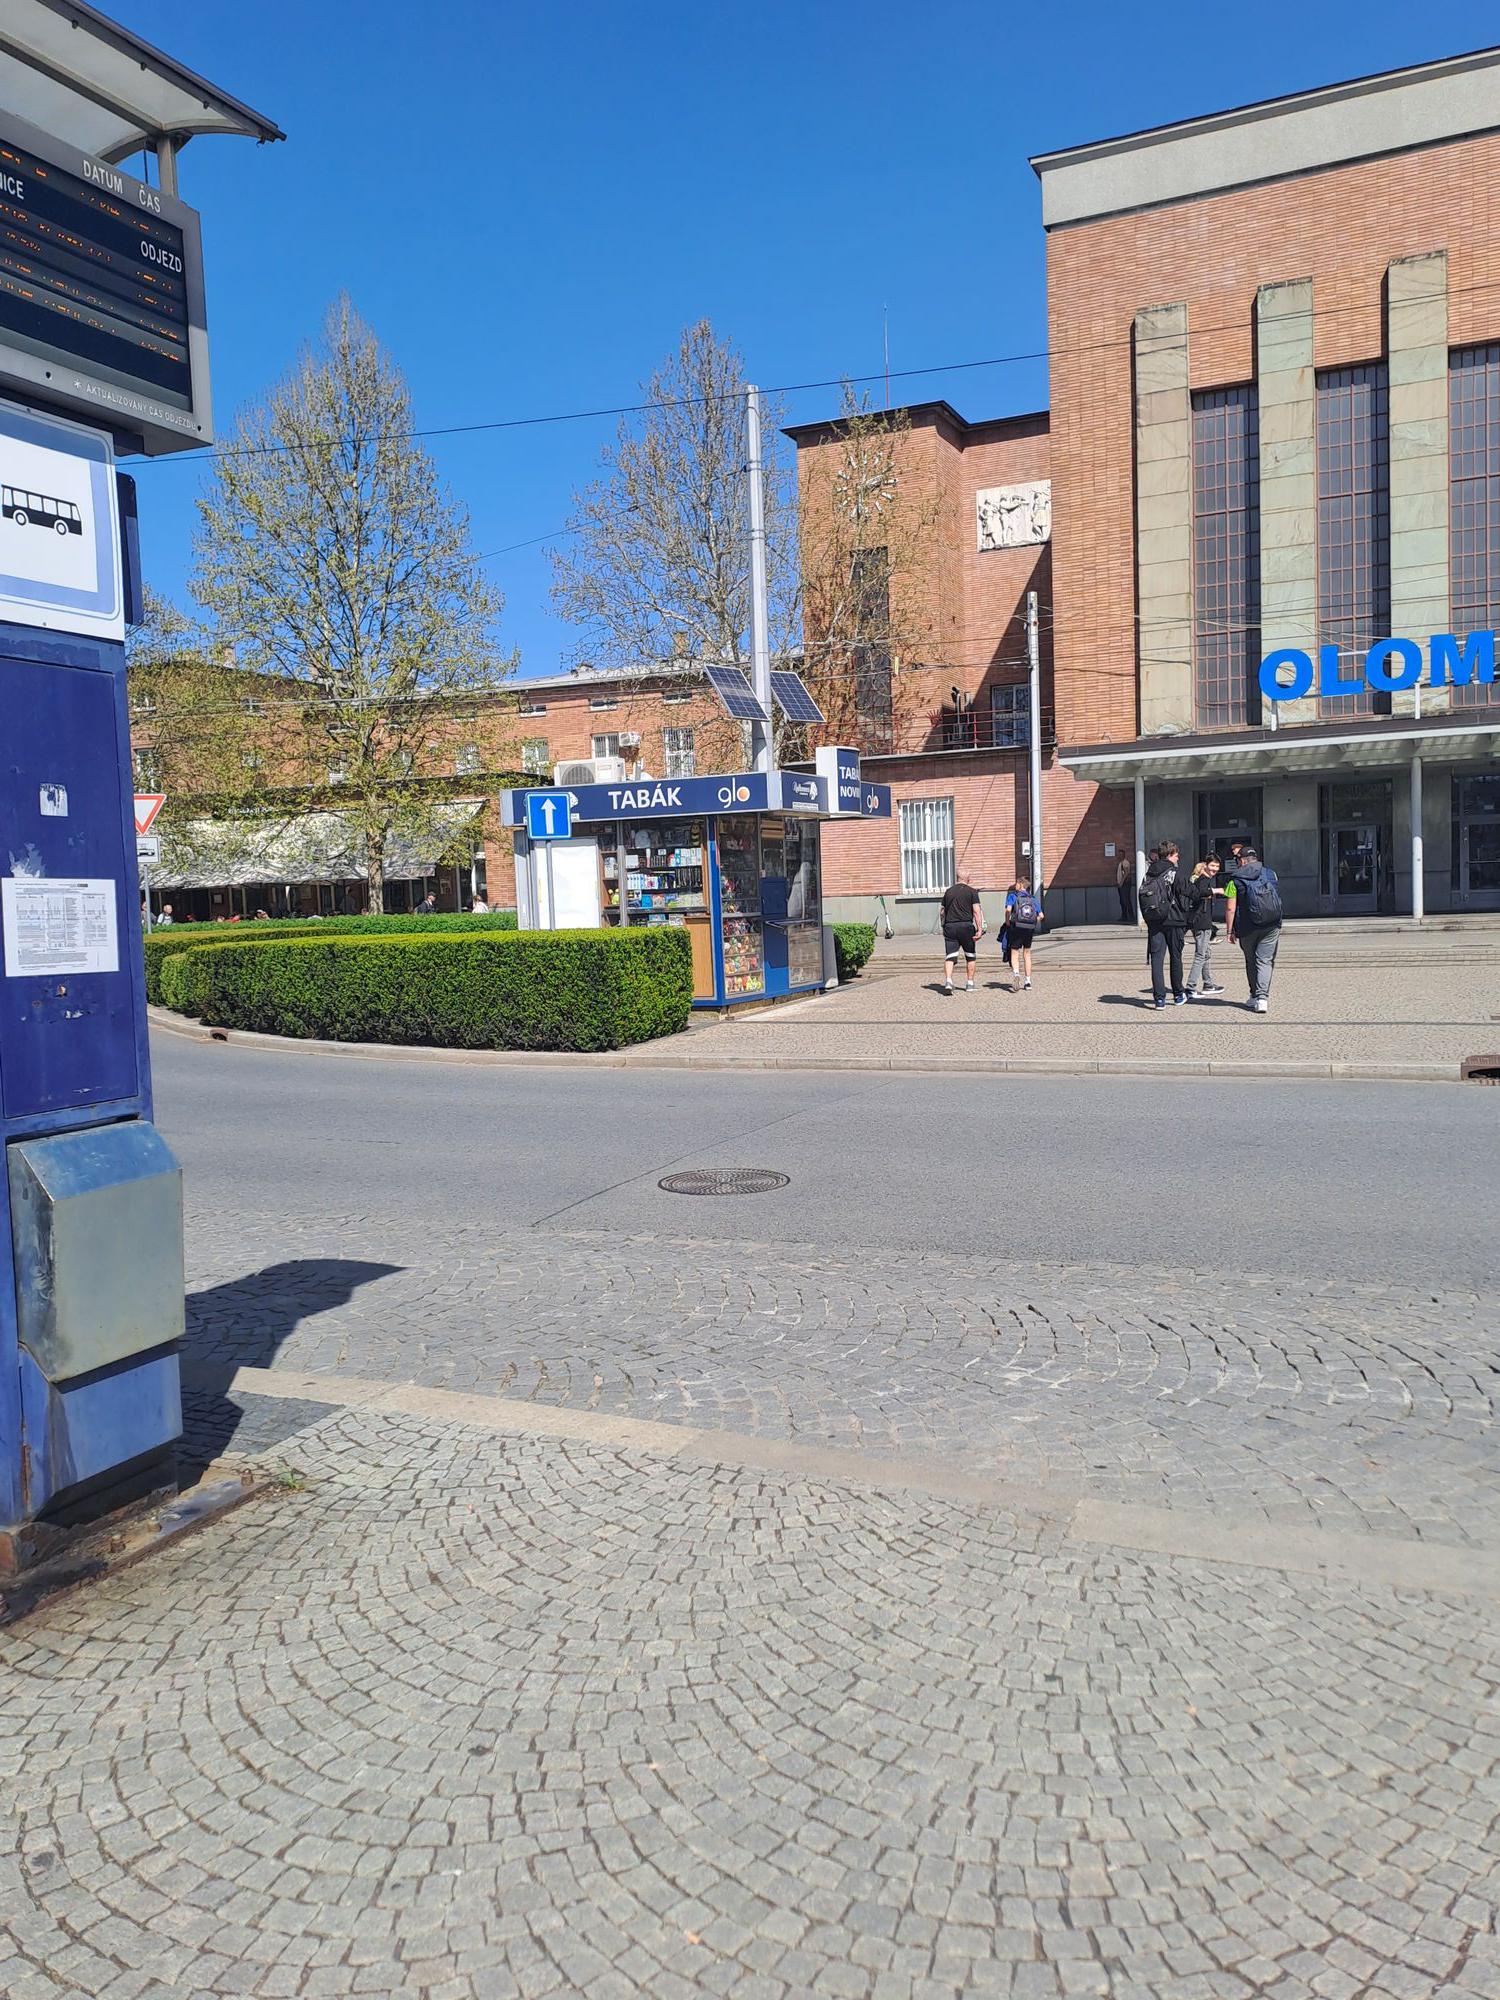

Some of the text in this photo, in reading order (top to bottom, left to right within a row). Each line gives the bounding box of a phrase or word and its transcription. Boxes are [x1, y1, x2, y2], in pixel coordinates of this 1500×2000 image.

[83, 159, 124, 194] DATUM
[139, 184, 161, 213] ČAS
[140, 240, 182, 273] ODJEZD
[1258, 630, 1495, 701] OLOM
[608, 783, 682, 810] TABÁK
[718, 777, 751, 808] glo
[866, 787, 879, 813] glo
